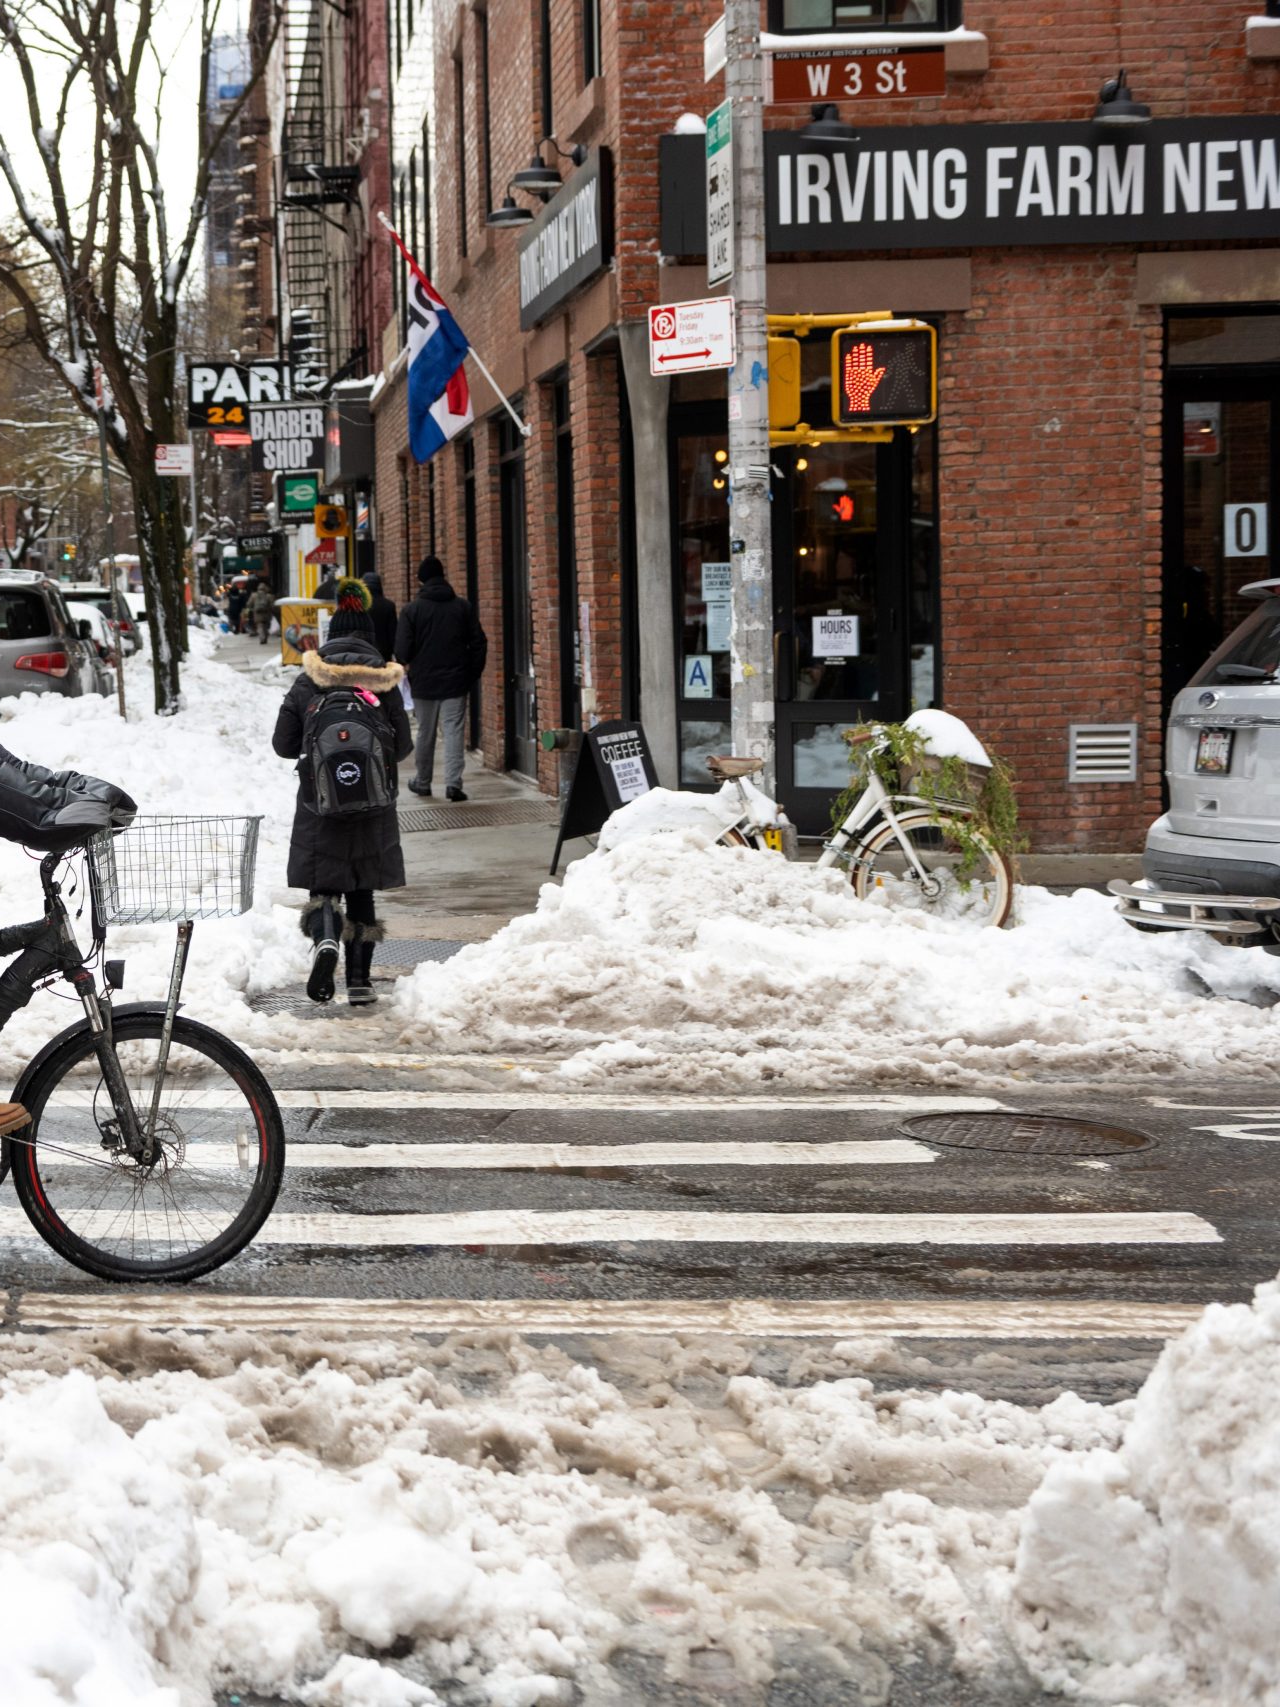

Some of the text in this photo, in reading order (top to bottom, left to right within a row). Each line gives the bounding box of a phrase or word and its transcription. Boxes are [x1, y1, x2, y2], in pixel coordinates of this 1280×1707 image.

[801, 50, 832, 58] VILLAGE
[833, 49, 865, 57] HISTORIC
[867, 47, 899, 56] DISTRICT
[807, 60, 908, 97] W 3 St
[778, 138, 1280, 226] IRVING FARM NEW
[713, 238, 728, 269] LANE
[207, 406, 245, 424] 24
[251, 408, 324, 441] BARBER
[263, 438, 314, 470] SHOP
[242, 537, 273, 547] CHESS
[820, 620, 852, 634] HOURS
[689, 660, 707, 687] A
[600, 740, 644, 764] COFFEE
